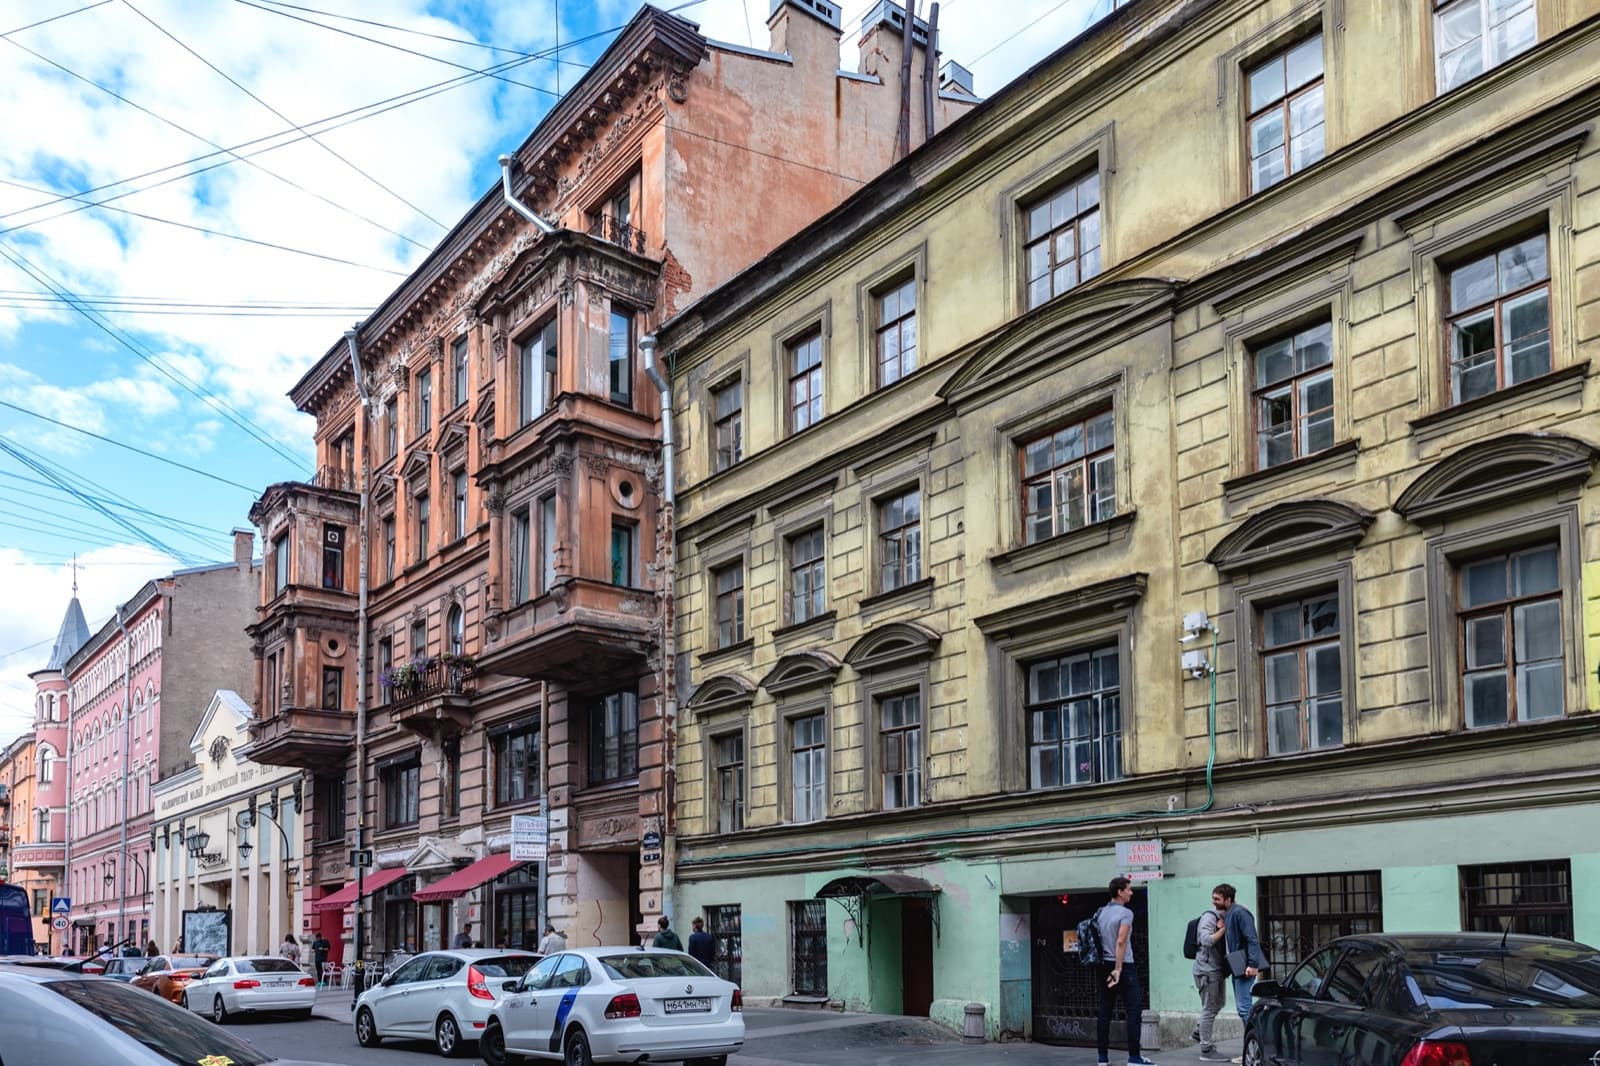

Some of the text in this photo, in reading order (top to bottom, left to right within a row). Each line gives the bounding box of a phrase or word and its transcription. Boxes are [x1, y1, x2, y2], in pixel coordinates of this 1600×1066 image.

[1132, 844, 1156, 852] САЛОН
[1128, 854, 1160, 863] КРАСОТЫ
[55, 920, 66, 928] 40
